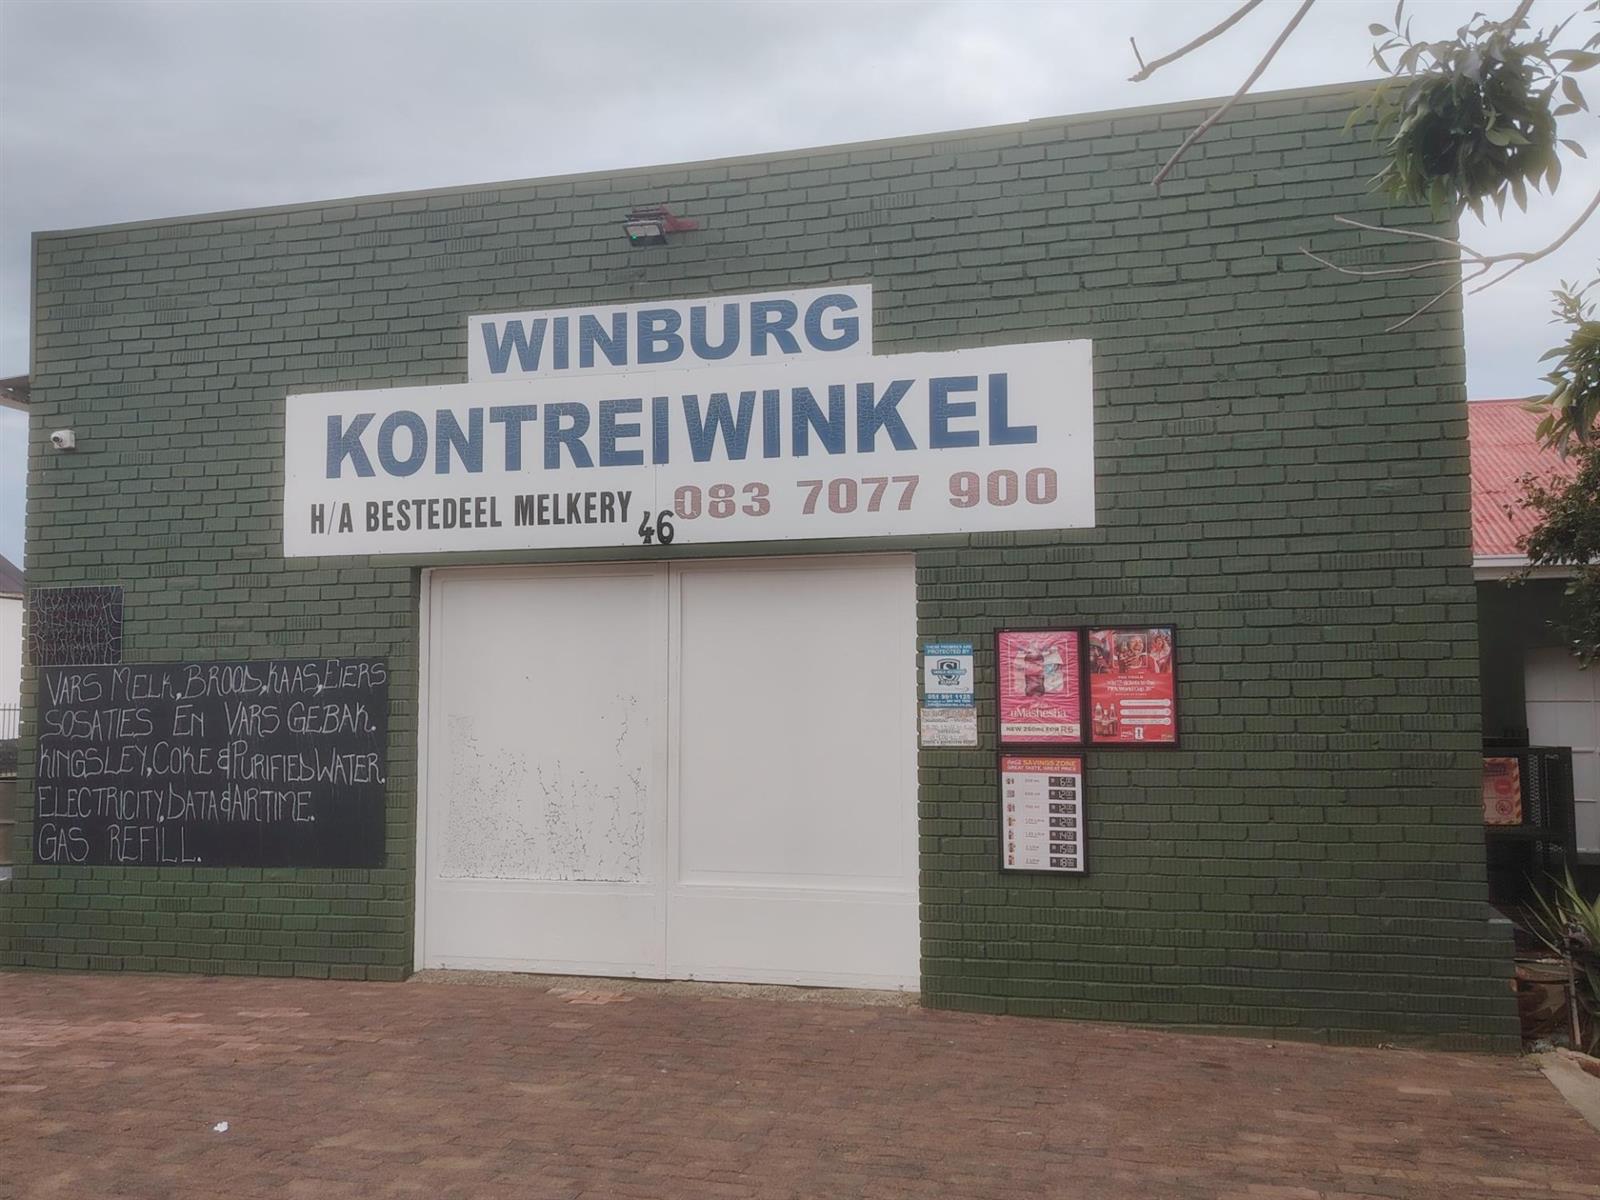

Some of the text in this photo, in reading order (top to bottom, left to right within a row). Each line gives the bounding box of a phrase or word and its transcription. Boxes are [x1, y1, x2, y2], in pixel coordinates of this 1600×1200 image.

[480, 293, 860, 374] WINBURG
[326, 372, 1038, 479] KONTREIWINKEL
[310, 490, 633, 535] H/A BESTEDEEL MELKERY
[673, 467, 1058, 520] 083 7077 900
[637, 509, 675, 545] 46
[46, 671, 102, 706] VARS
[323, 659, 387, 689] EIERS
[39, 701, 377, 742] SOSATIES EN VARS GEBAK.
[152, 741, 212, 776] COKE
[231, 740, 315, 782] PURIFIED
[315, 747, 386, 786] WATER.
[167, 781, 219, 824] DATA
[231, 783, 316, 823] AIRTIME.
[38, 823, 202, 862] GAS REFILL.
